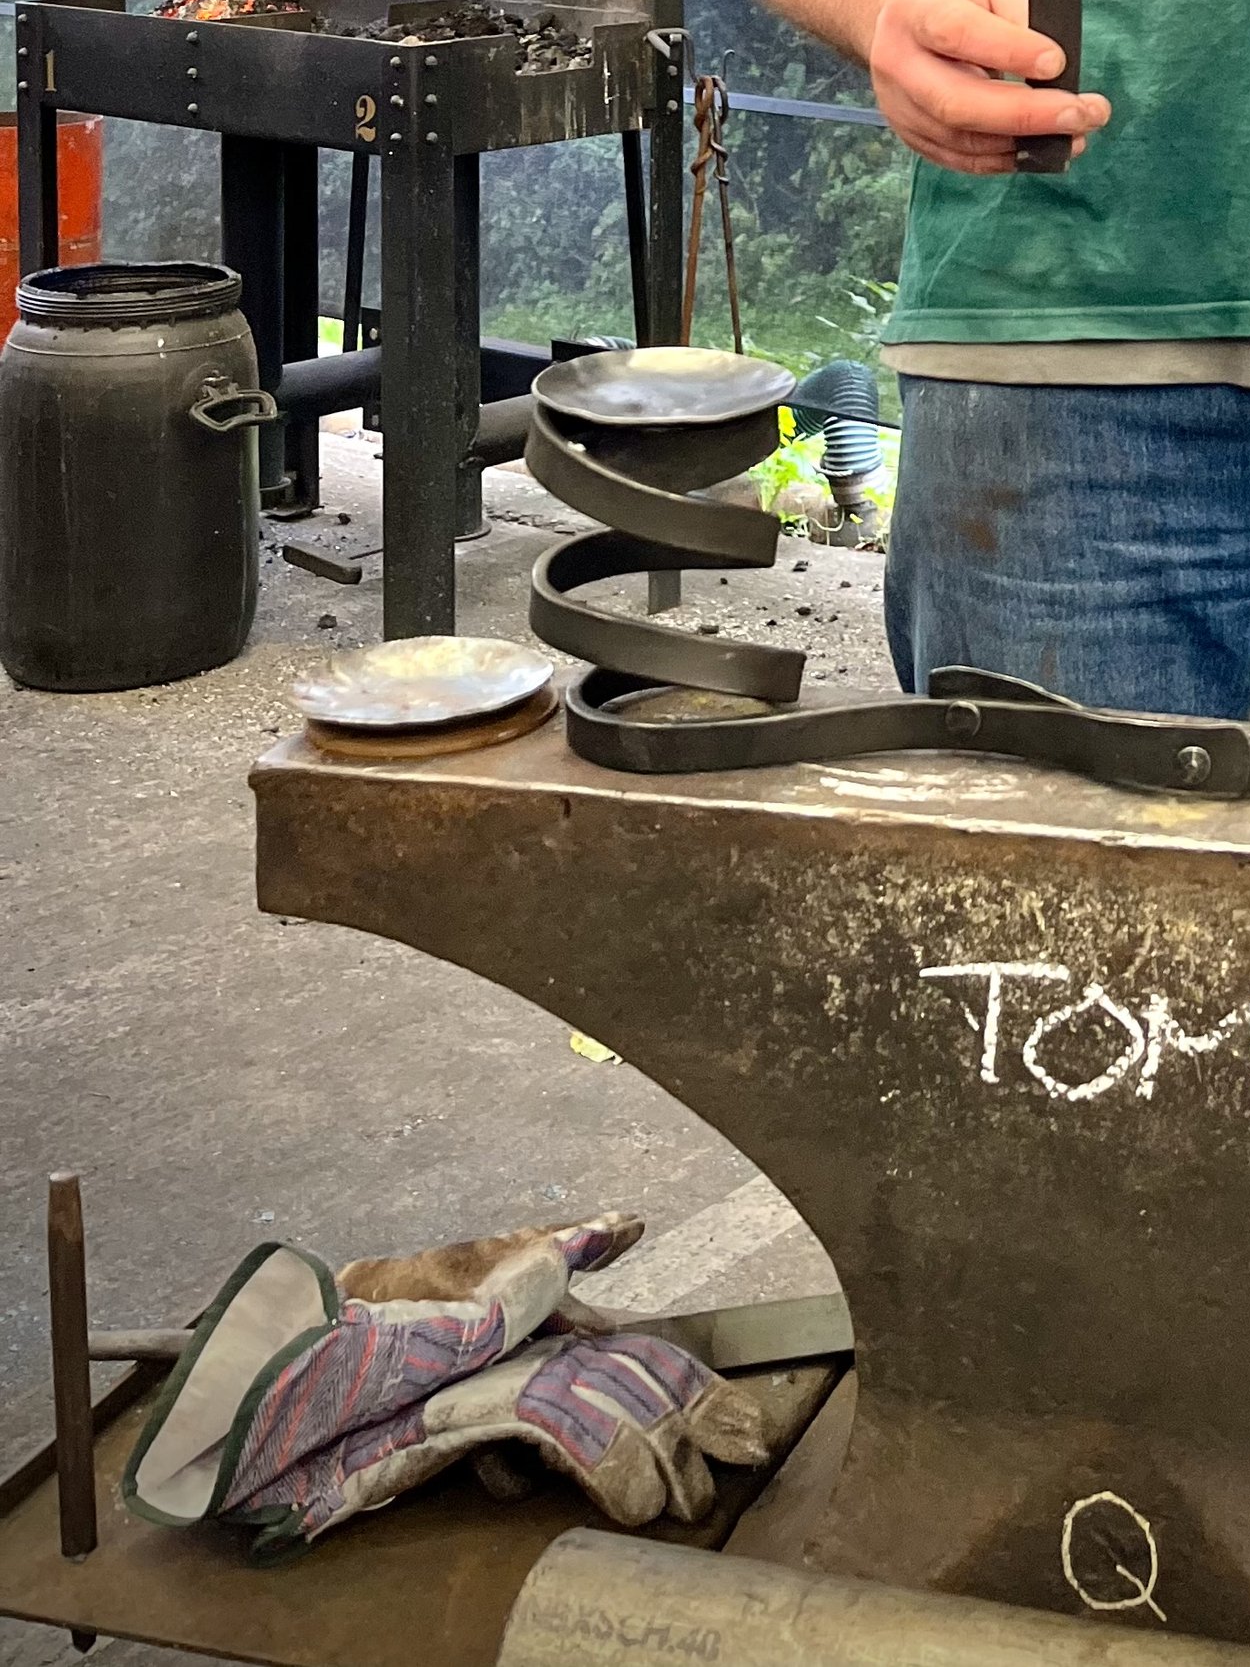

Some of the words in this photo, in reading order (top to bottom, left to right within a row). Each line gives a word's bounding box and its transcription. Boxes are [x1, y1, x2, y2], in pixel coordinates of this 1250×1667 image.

[45, 49, 57, 92] 1
[355, 94, 376, 142] 2
[1061, 1490, 1168, 1622] Q
